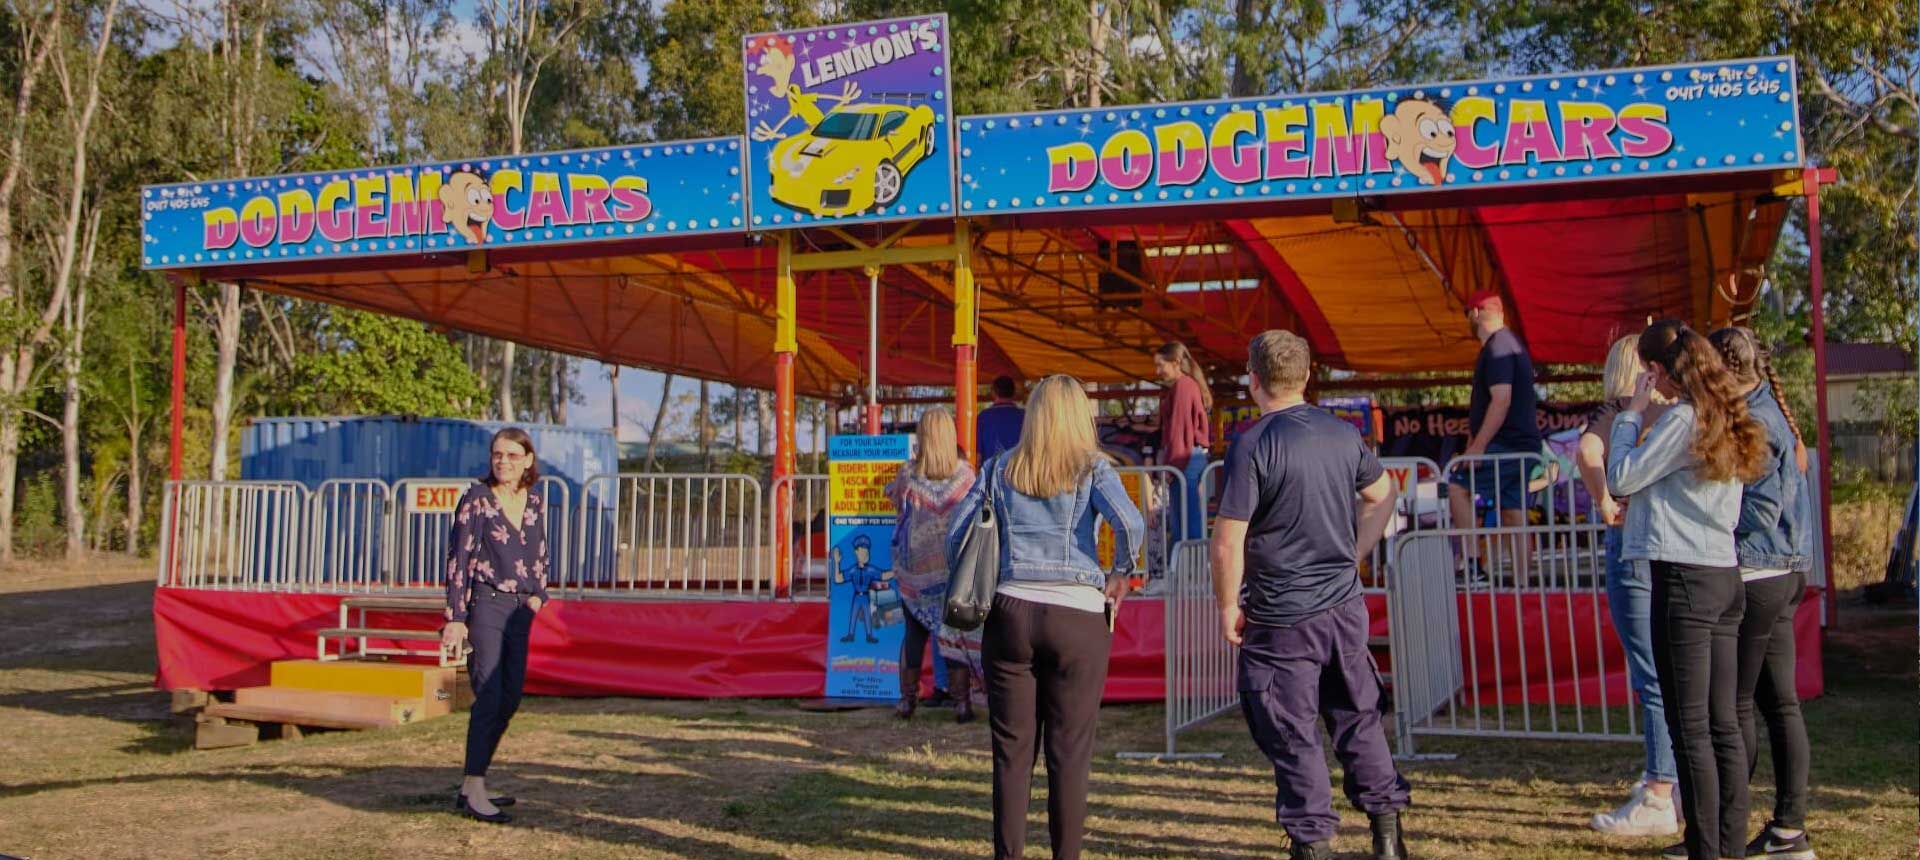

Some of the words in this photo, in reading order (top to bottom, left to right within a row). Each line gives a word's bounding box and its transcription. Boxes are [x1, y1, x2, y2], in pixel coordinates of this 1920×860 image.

[801, 23, 939, 88] LENNON'S
[1665, 83, 1705, 100] 0417
[1708, 82, 1742, 98] 405
[1746, 79, 1780, 96] 645
[1046, 98, 1391, 193] DODGEM
[1453, 98, 1674, 168] CARS
[203, 170, 448, 250] DODGEM
[490, 169, 653, 231] CARS
[1394, 416, 1420, 437] No
[832, 448, 861, 457] MEASURE
[864, 448, 880, 457] YOUR
[882, 448, 906, 457] HEIGHT
[840, 438, 852, 447] FOR
[855, 438, 872, 447] YOUR
[873, 437, 897, 447] SAFETY
[837, 463, 867, 473] RIDERS
[416, 487, 459, 509] EXIT
[844, 488, 854, 498] BE
[858, 488, 880, 498] WITH
[834, 501, 863, 512] ADULT
[865, 501, 877, 512] TO
